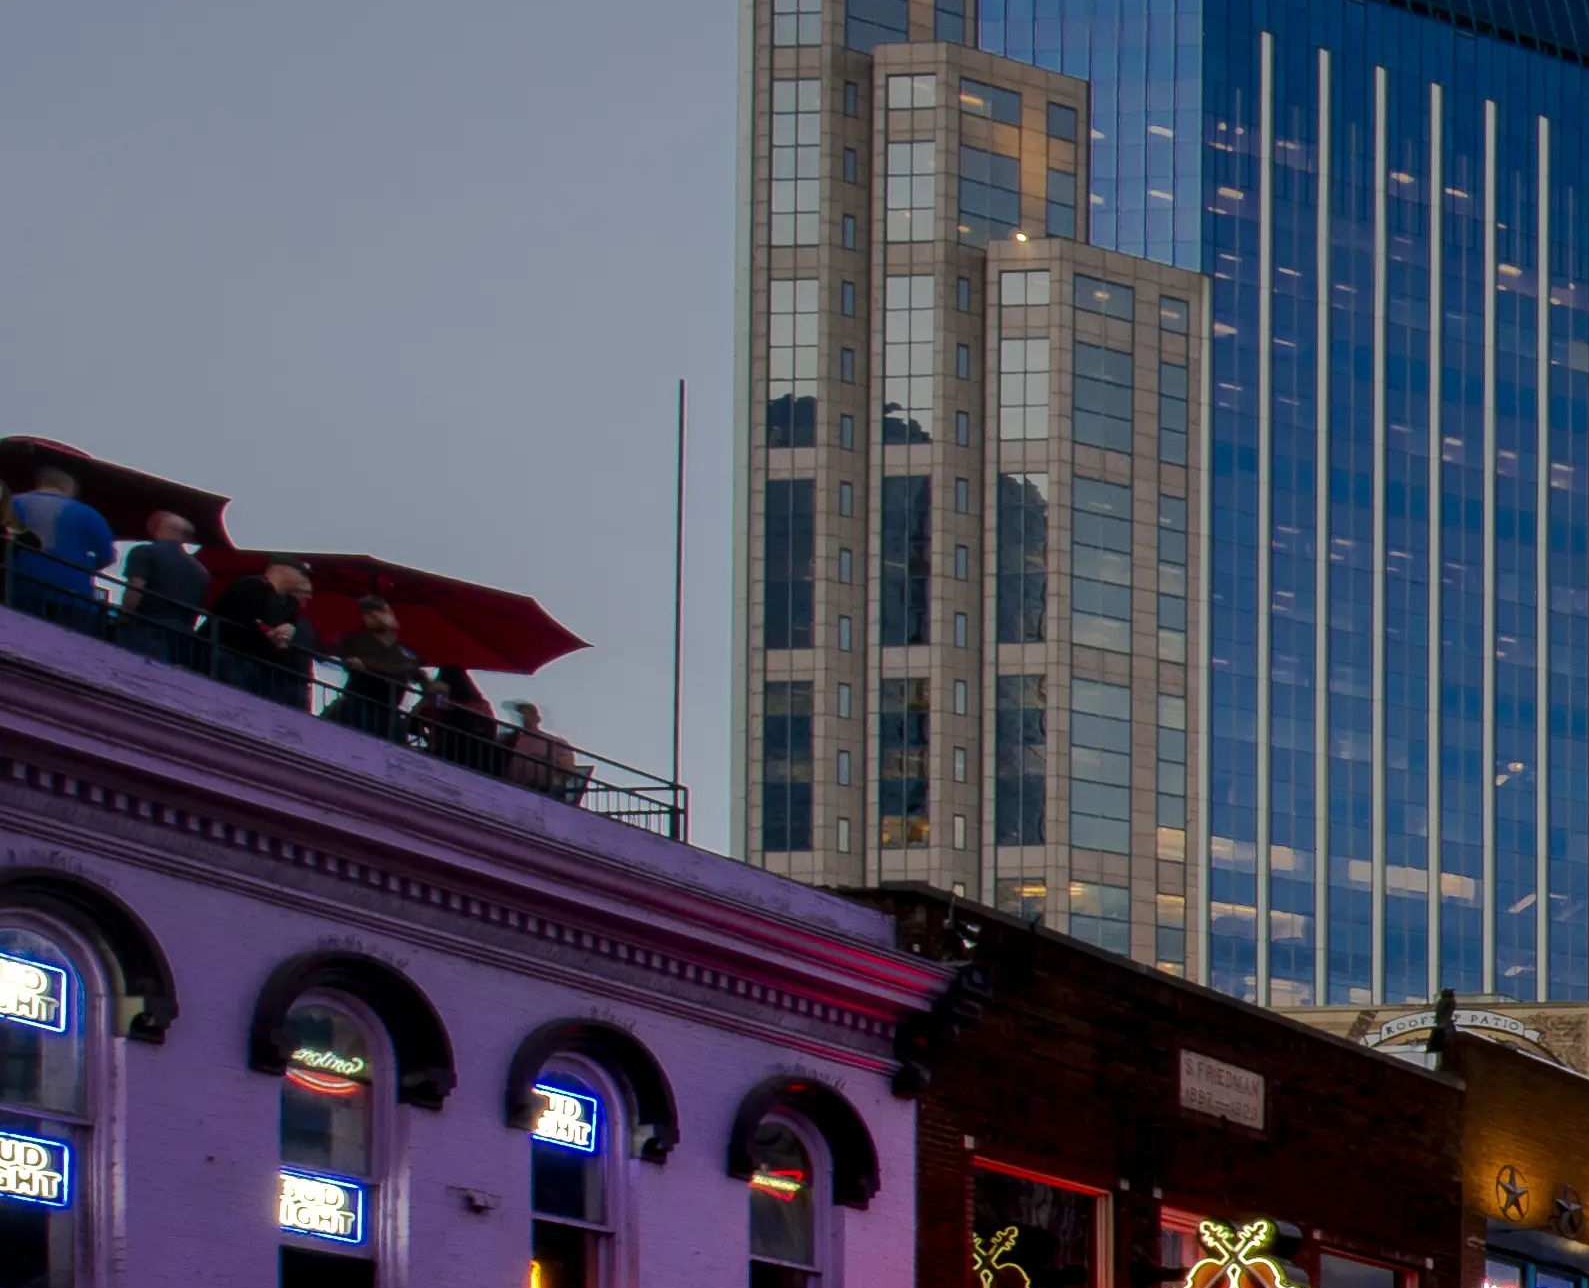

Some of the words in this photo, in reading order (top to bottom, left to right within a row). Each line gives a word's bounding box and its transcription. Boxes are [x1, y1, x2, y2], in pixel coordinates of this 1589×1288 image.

[1386, 1013, 1461, 1035] ROOFTP
[1470, 1014, 1520, 1031] PATIO
[0, 1139, 50, 1174] UD
